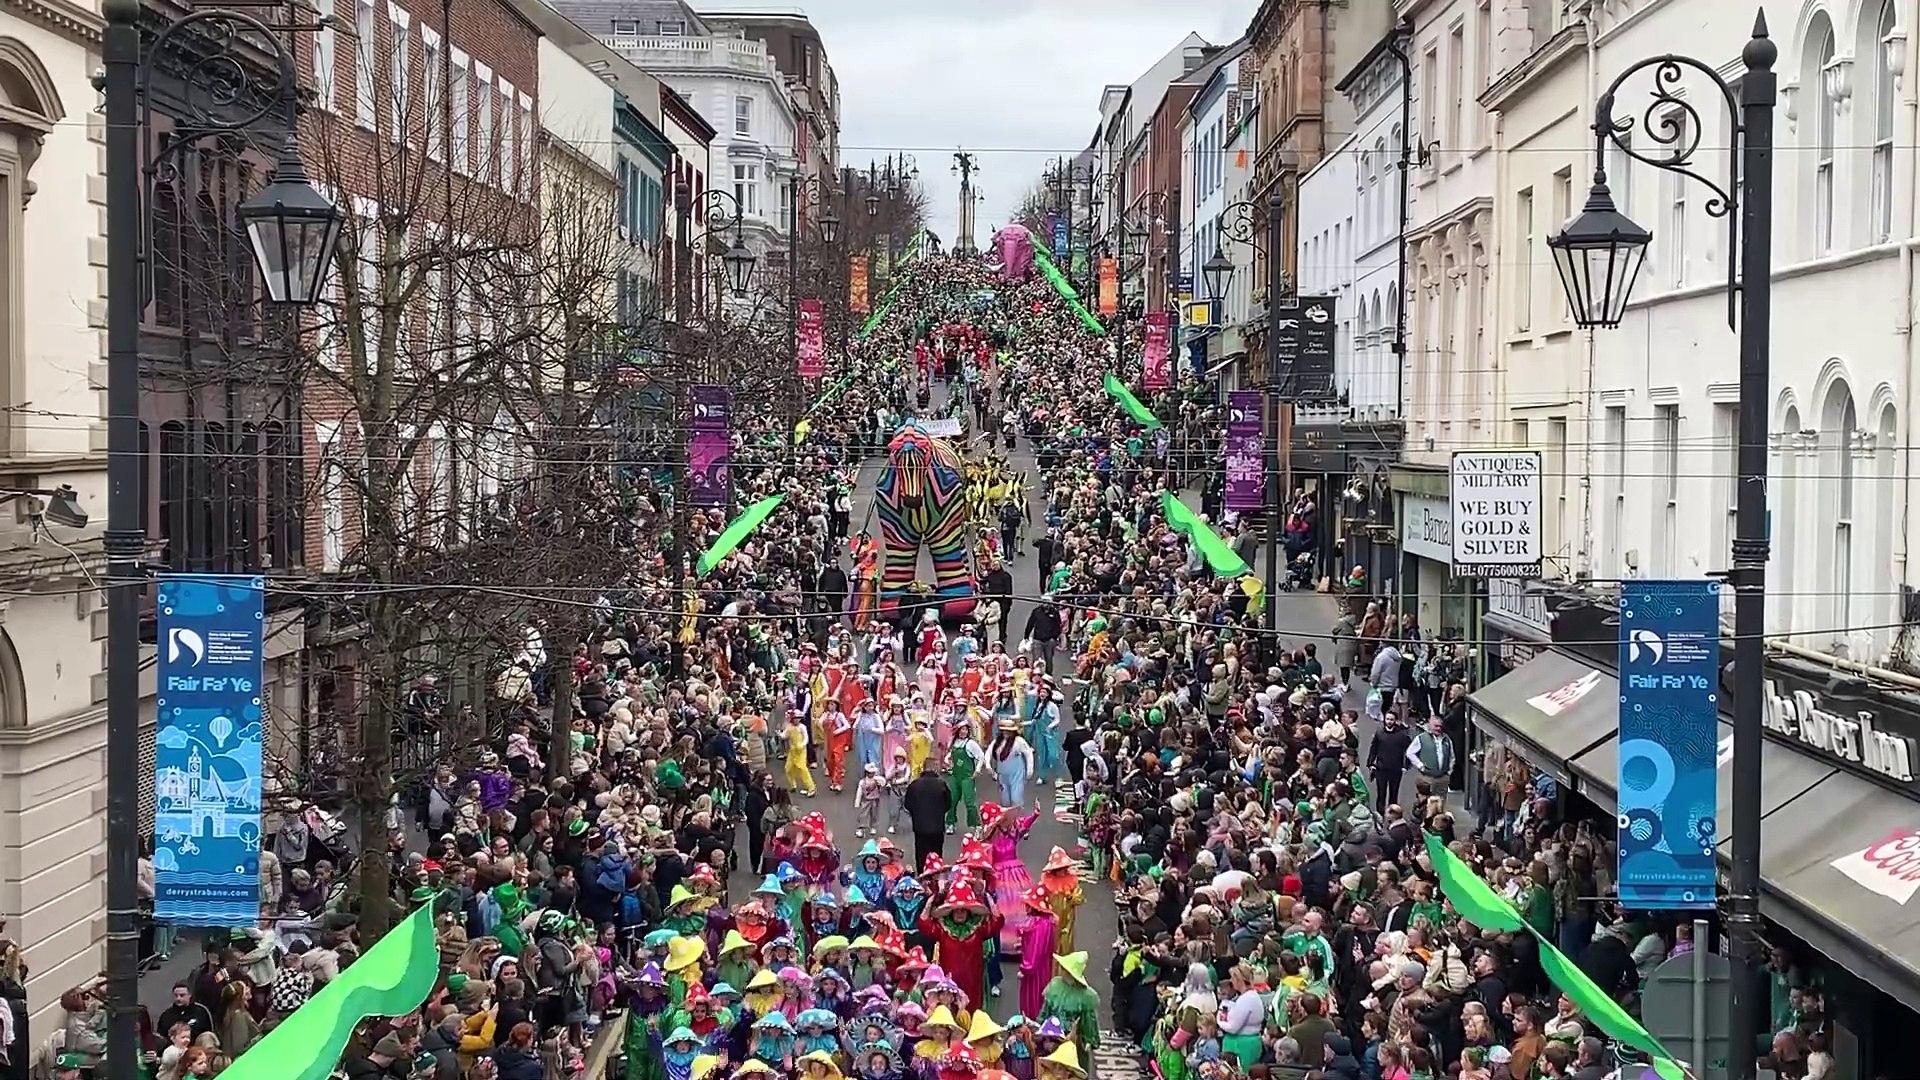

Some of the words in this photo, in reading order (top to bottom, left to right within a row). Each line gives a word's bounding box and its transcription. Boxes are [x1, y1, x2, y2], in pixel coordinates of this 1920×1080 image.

[1456, 458, 1537, 473] ANTIQUES,
[1462, 474, 1532, 487] MILITARY
[1460, 500, 1489, 515] WE
[1494, 500, 1532, 515] BUY
[1461, 520, 1514, 535] GOLD
[1518, 520, 1531, 535] &
[1463, 540, 1529, 555] SILVER
[167, 676, 200, 691] Fair
[230, 677, 253, 692] Ye
[1629, 674, 1660, 689] Fair
[1687, 675, 1709, 689] Ye
[1762, 677, 1798, 736] he
[1857, 710, 1914, 783] Inn
[165, 887, 249, 897] derrystrabane.com
